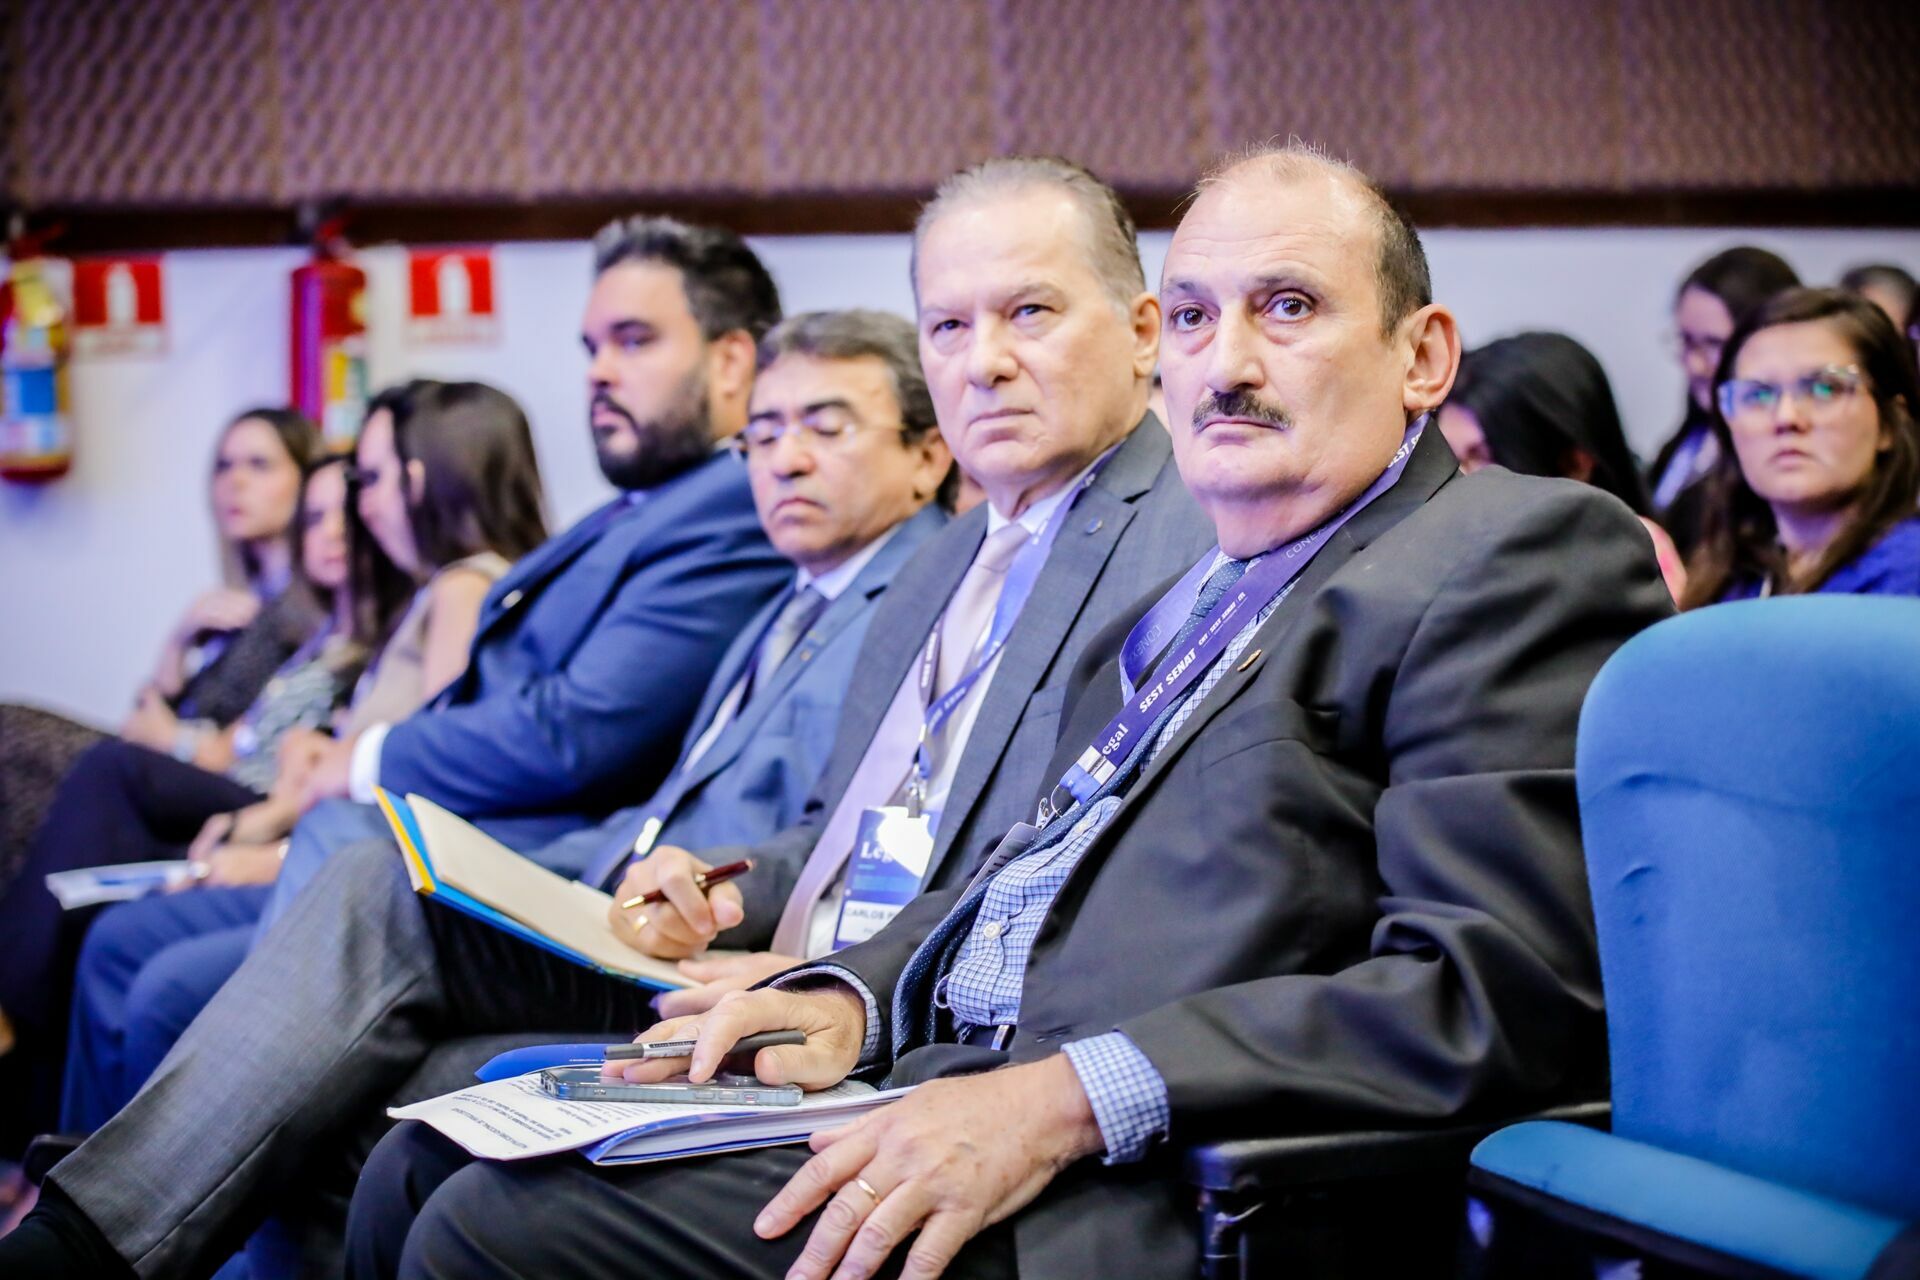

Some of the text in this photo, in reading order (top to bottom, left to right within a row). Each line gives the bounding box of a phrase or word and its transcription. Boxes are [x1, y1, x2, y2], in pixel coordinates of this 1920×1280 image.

[1139, 648, 1197, 713] SEST SENAT
[1102, 723, 1129, 757] egal
